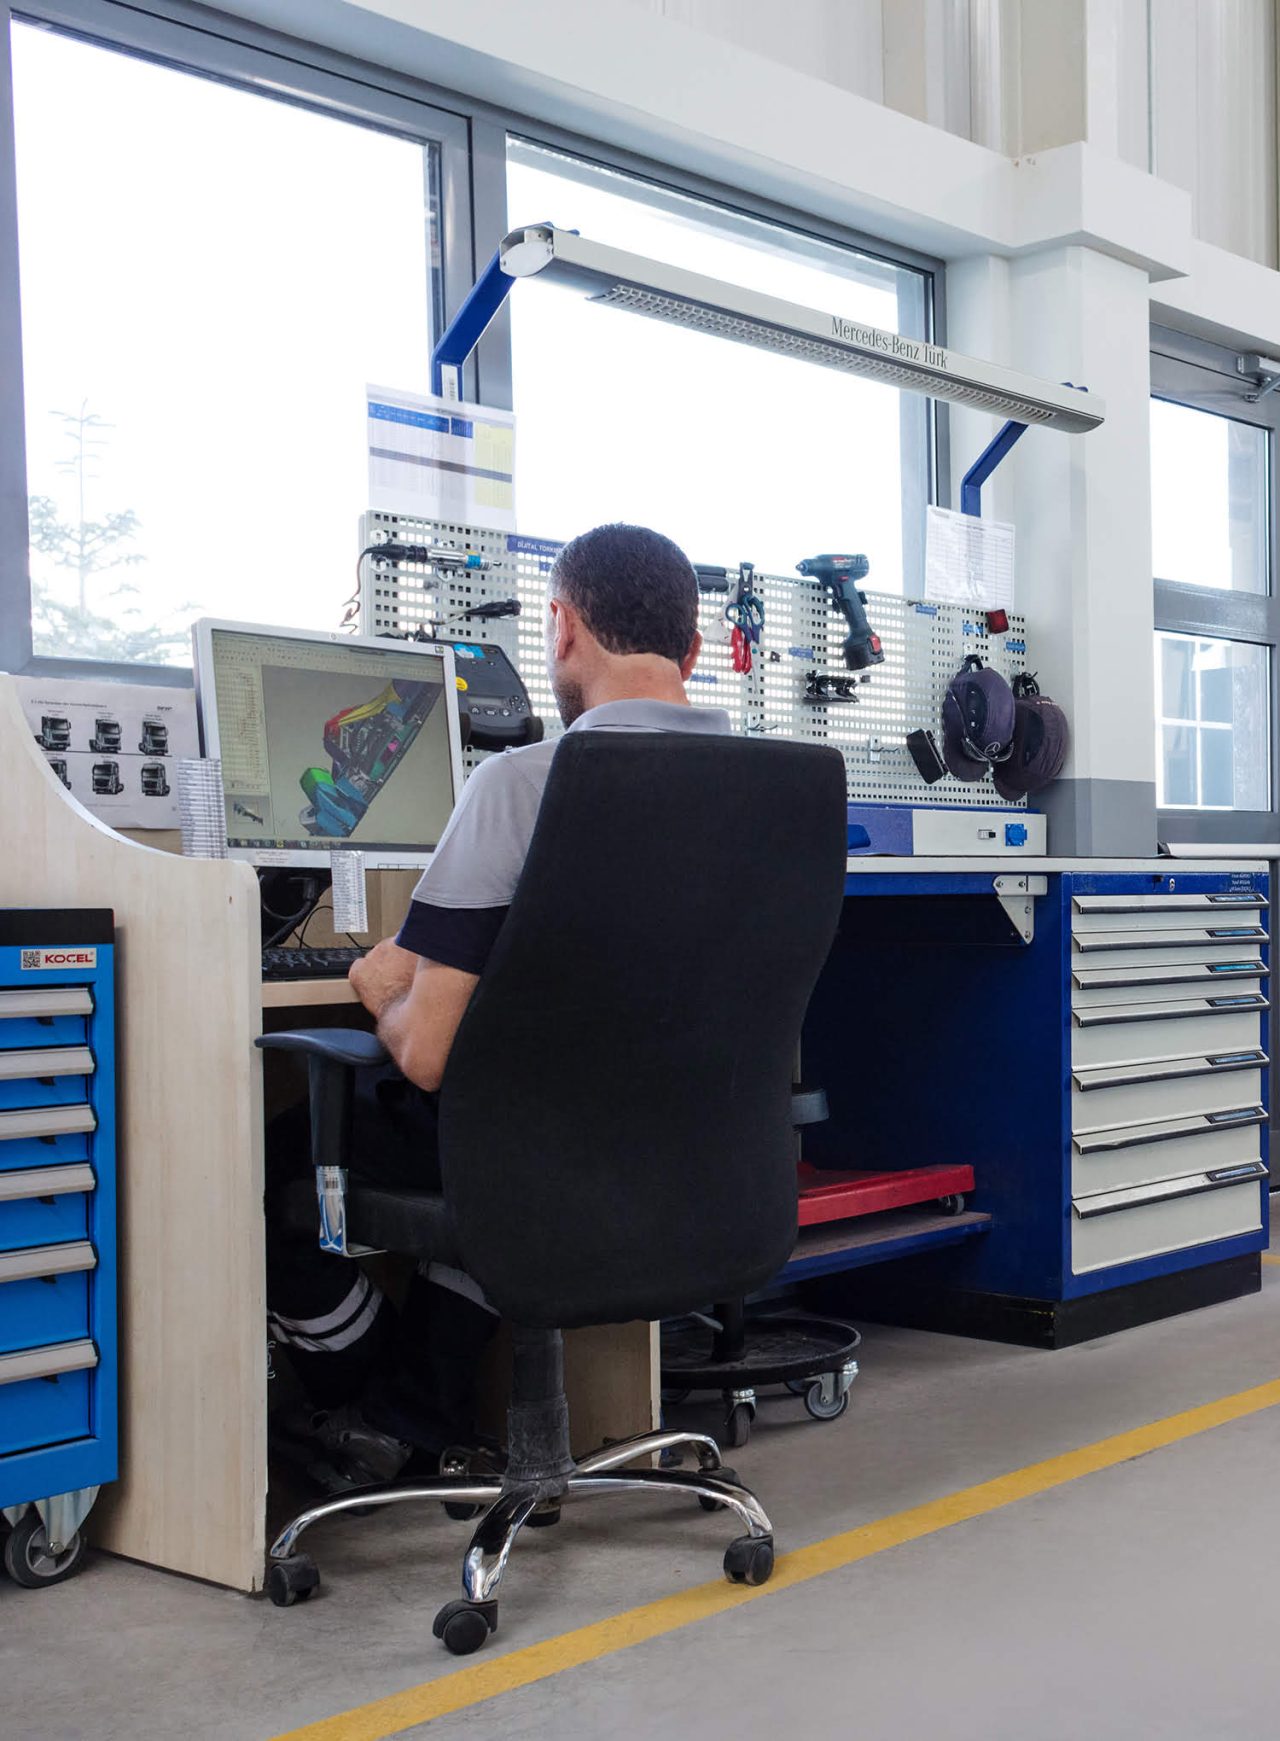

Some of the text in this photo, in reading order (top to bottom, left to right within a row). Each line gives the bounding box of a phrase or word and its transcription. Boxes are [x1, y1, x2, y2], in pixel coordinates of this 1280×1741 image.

[831, 316, 948, 369] Mercedes-Benz Türk
[45, 954, 93, 963] KOCEL
